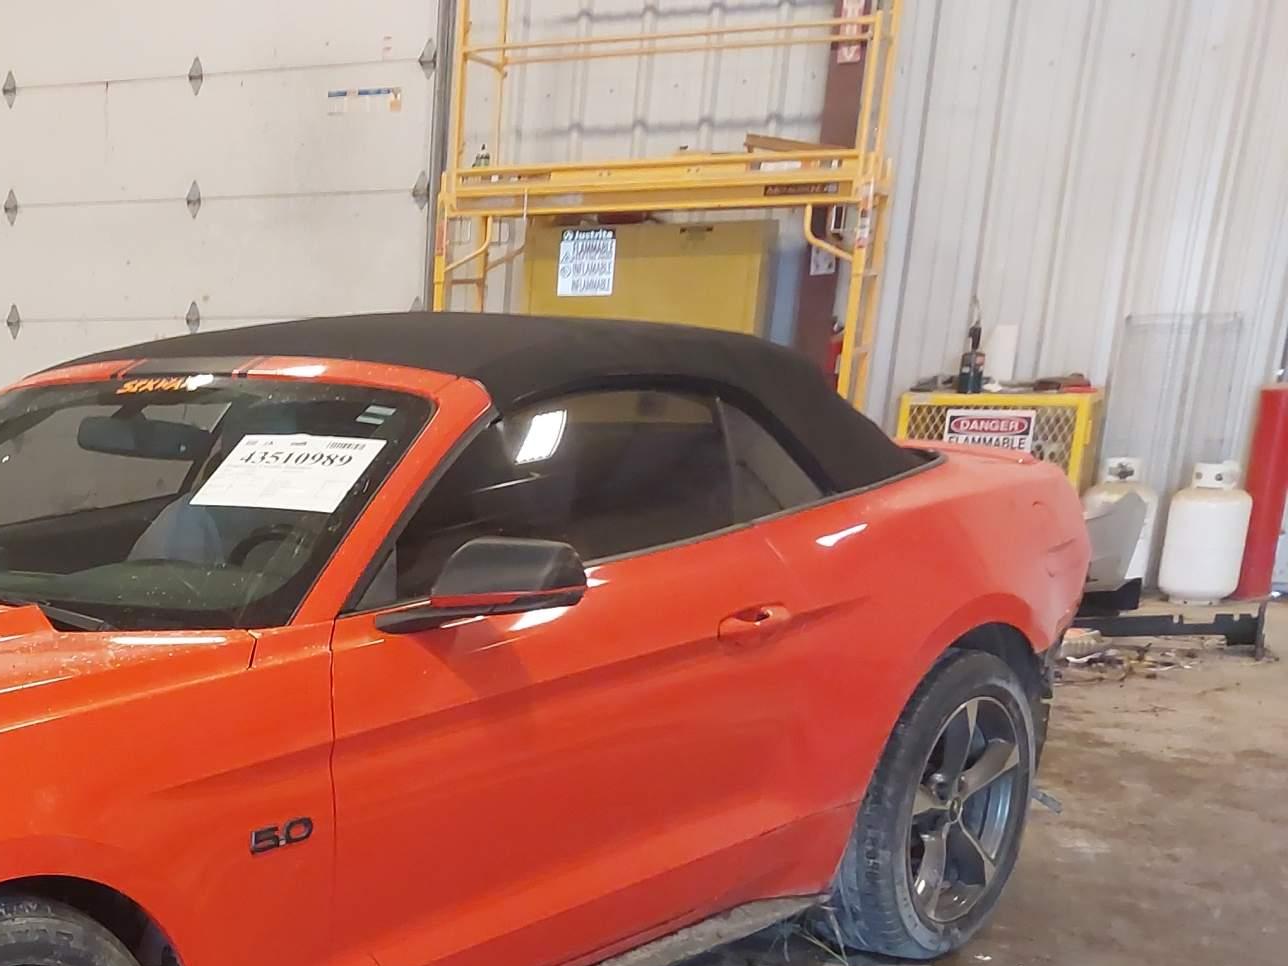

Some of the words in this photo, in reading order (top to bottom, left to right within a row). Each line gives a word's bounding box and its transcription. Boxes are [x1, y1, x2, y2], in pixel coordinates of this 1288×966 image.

[958, 418, 1020, 433] DANGER
[240, 450, 353, 467] 43510989
[251, 816, 313, 854] 5.0
